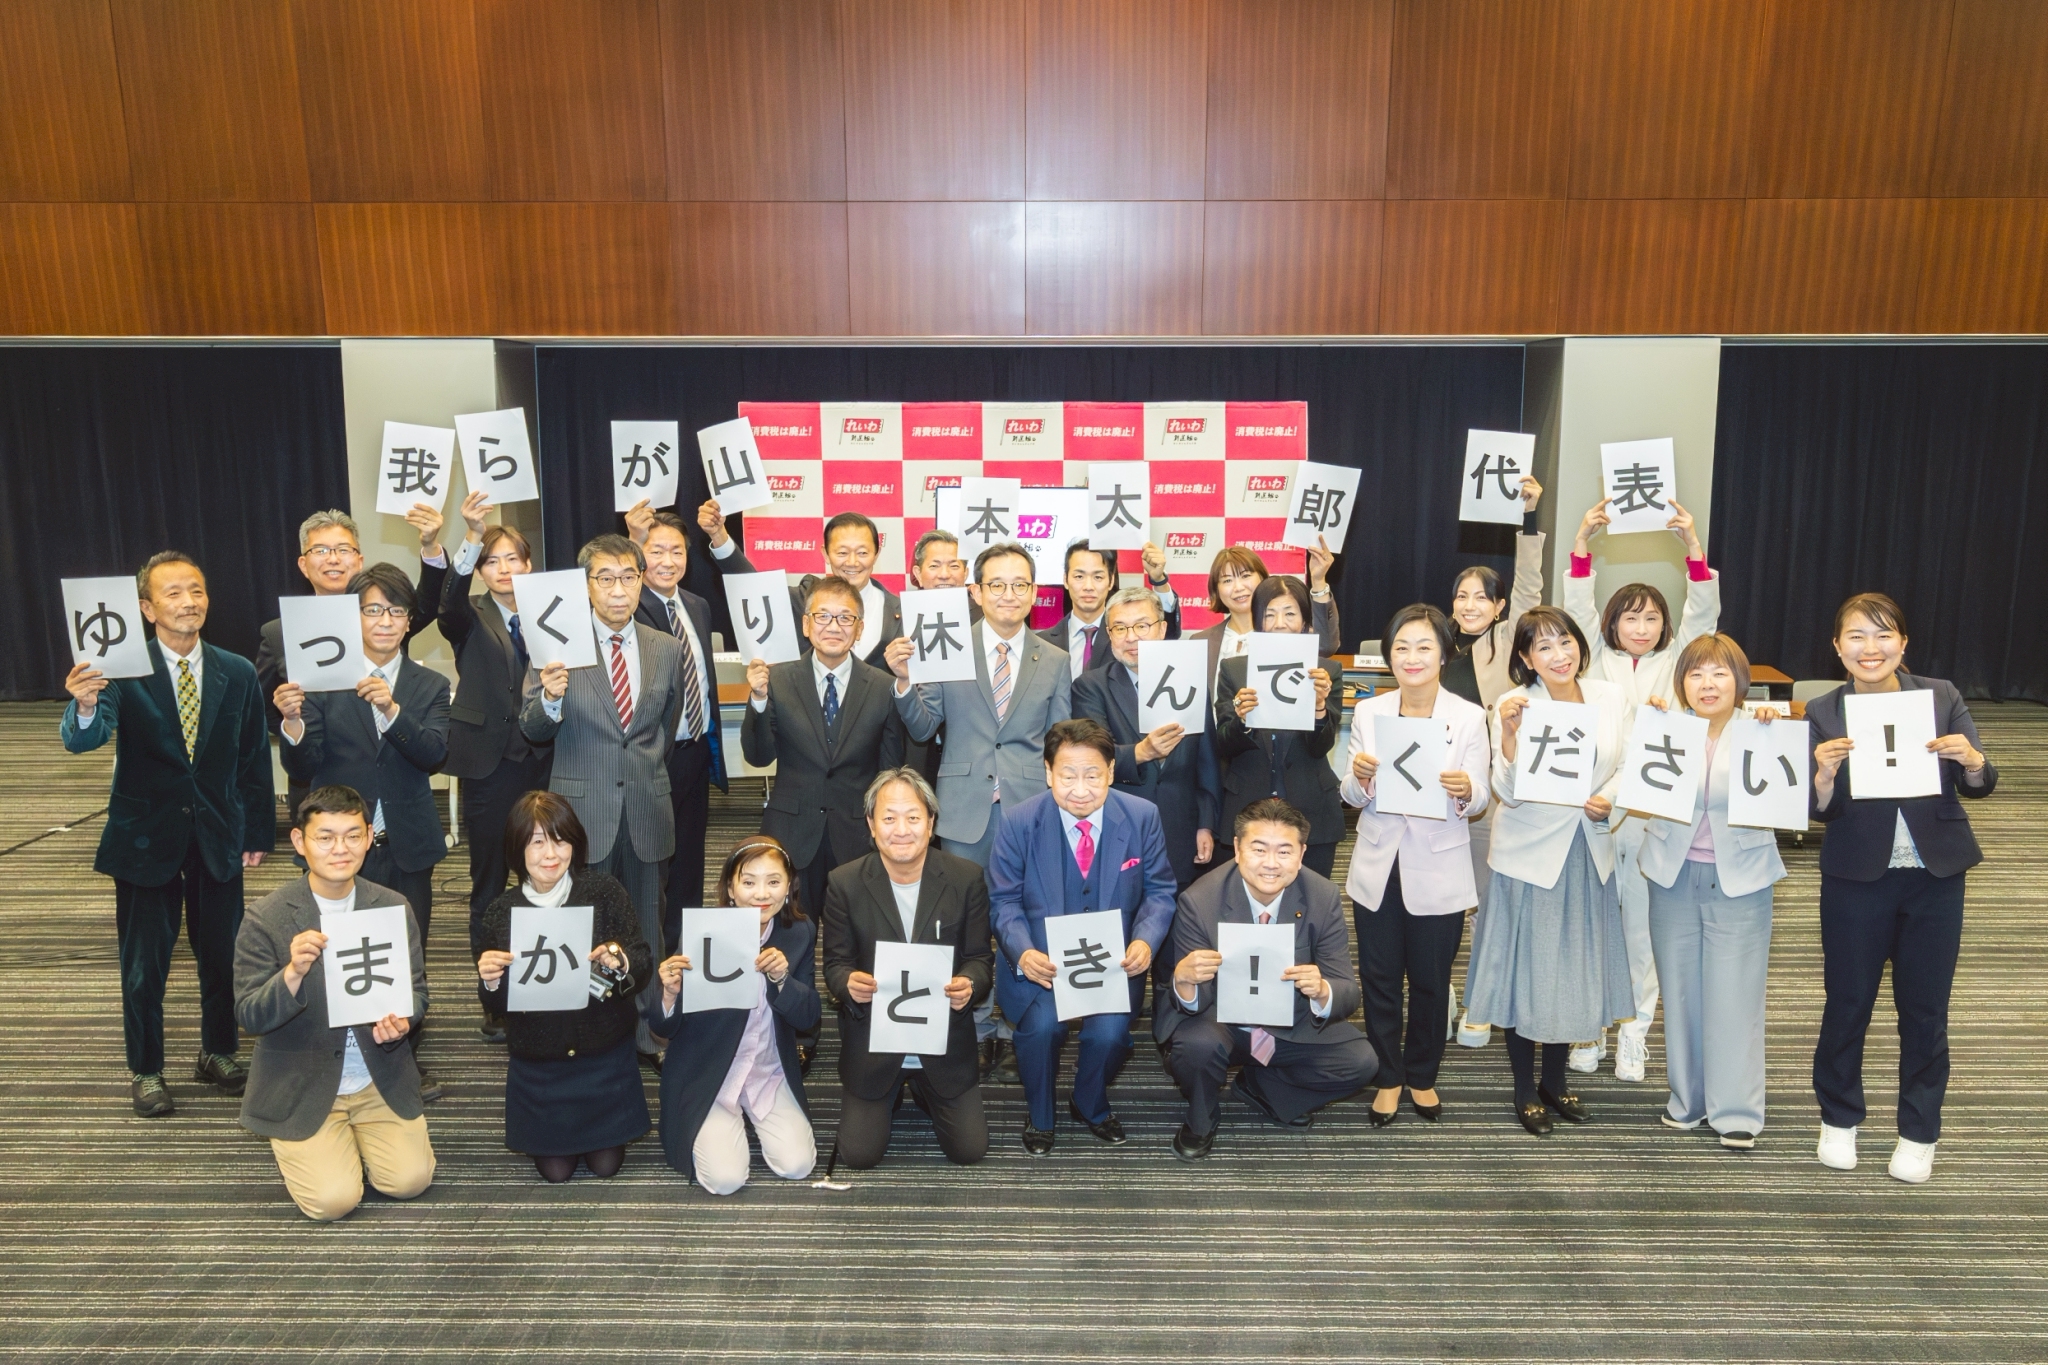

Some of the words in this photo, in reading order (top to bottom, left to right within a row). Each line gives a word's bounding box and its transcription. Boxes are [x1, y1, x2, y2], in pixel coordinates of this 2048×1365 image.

[846, 419, 878, 432] れいわ
[911, 426, 974, 437] 消費税は廃止!
[1007, 420, 1039, 433] れいわ
[1073, 426, 1135, 437] 消費税は廃止!
[1169, 420, 1201, 432] れいわ
[1235, 426, 1298, 437] 消費税は廃止!
[387, 447, 441, 496] 我
[479, 437, 518, 482] ら
[621, 441, 671, 488] が
[707, 446, 756, 496] 山
[1250, 477, 1282, 489] れいわ
[1470, 453, 1521, 501] 代
[832, 483, 894, 494] 消費税は廃止!
[1094, 484, 1143, 530] 太
[1154, 483, 1216, 494] 消費税は廃止!
[1293, 483, 1347, 532] 郎
[1612, 462, 1666, 515] 表
[964, 498, 1010, 544] 本
[1168, 533, 1201, 546] れいわ
[754, 540, 816, 551] 消費税は廃止!
[75, 601, 128, 657] ゆ
[537, 595, 570, 645] く
[741, 596, 774, 645] り
[909, 611, 964, 662] 休
[298, 636, 346, 668] つ
[1146, 664, 1197, 711] ん
[1257, 662, 1305, 705] で
[1393, 741, 1423, 792] く
[1528, 725, 1585, 779] だ
[1641, 734, 1686, 792] さ
[1883, 724, 1897, 767] !
[1742, 749, 1798, 796] い
[336, 936, 395, 996] ま
[517, 934, 580, 986] か
[702, 937, 745, 984] し
[1063, 937, 1112, 990] き
[1249, 955, 1260, 995] !
[886, 970, 932, 1025] と
